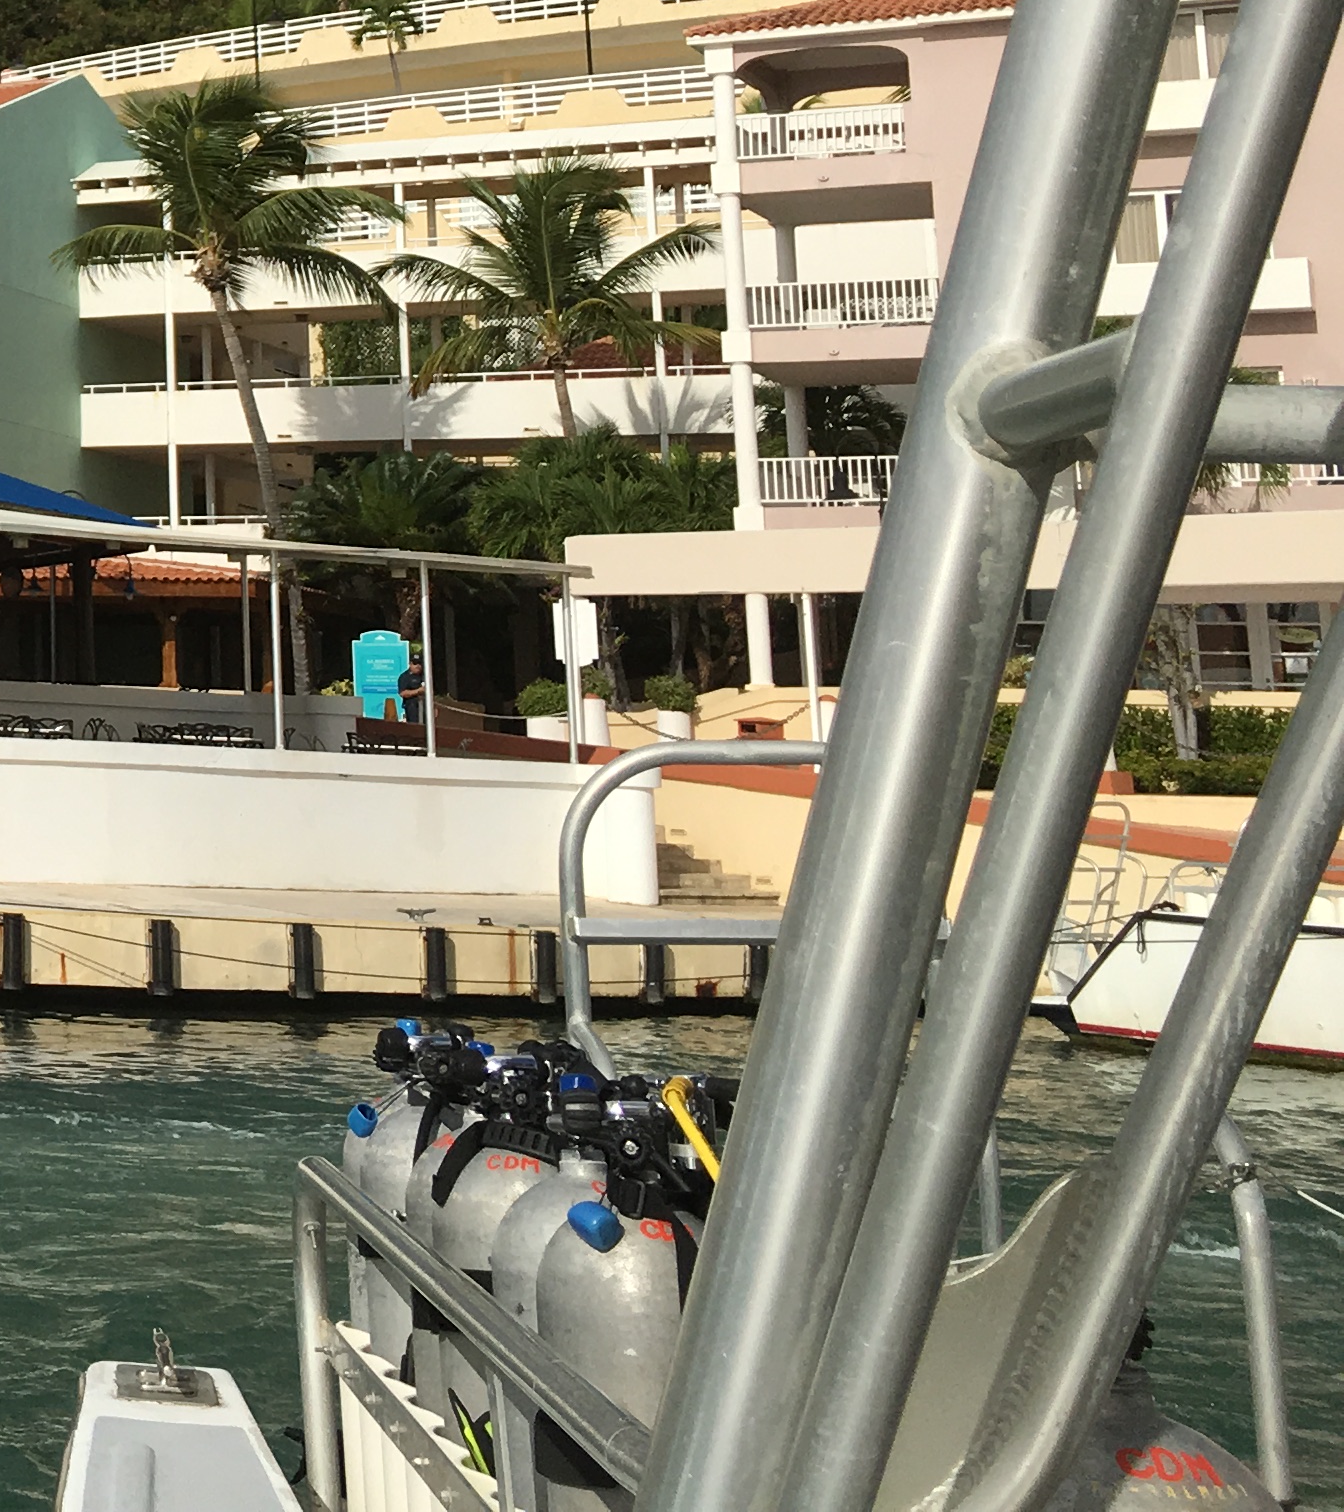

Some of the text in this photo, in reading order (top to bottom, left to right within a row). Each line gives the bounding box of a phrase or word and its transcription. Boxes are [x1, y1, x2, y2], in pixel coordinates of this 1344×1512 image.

[486, 1154, 540, 1174] CDM
[639, 1219, 694, 1242] CD
[1115, 1446, 1224, 1487] CDM
